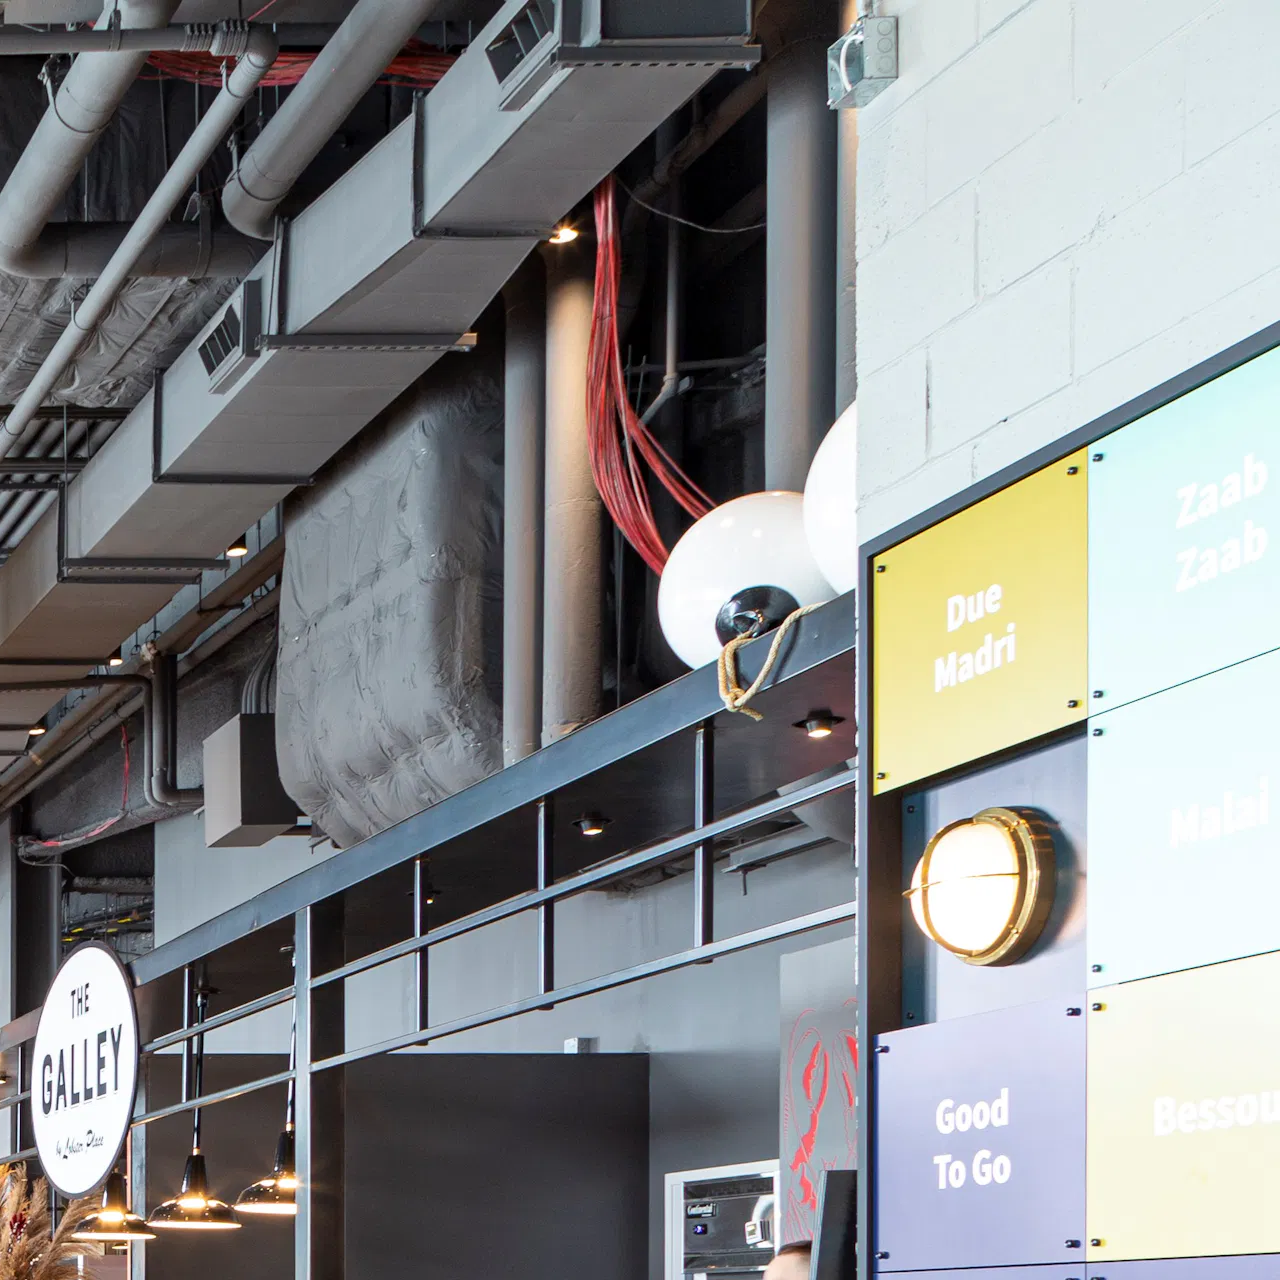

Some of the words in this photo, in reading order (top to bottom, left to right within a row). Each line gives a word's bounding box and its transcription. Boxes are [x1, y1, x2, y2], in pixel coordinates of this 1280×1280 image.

[1175, 453, 1268, 529] Zaab
[1175, 520, 1268, 593] Zaab
[947, 583, 1003, 633] Due
[934, 623, 1016, 692] Madri
[70, 982, 90, 1019] THE
[42, 1024, 122, 1115] GALLEY
[935, 1087, 1010, 1136] Good
[933, 1154, 968, 1190] To
[972, 1149, 1012, 1186] Go
